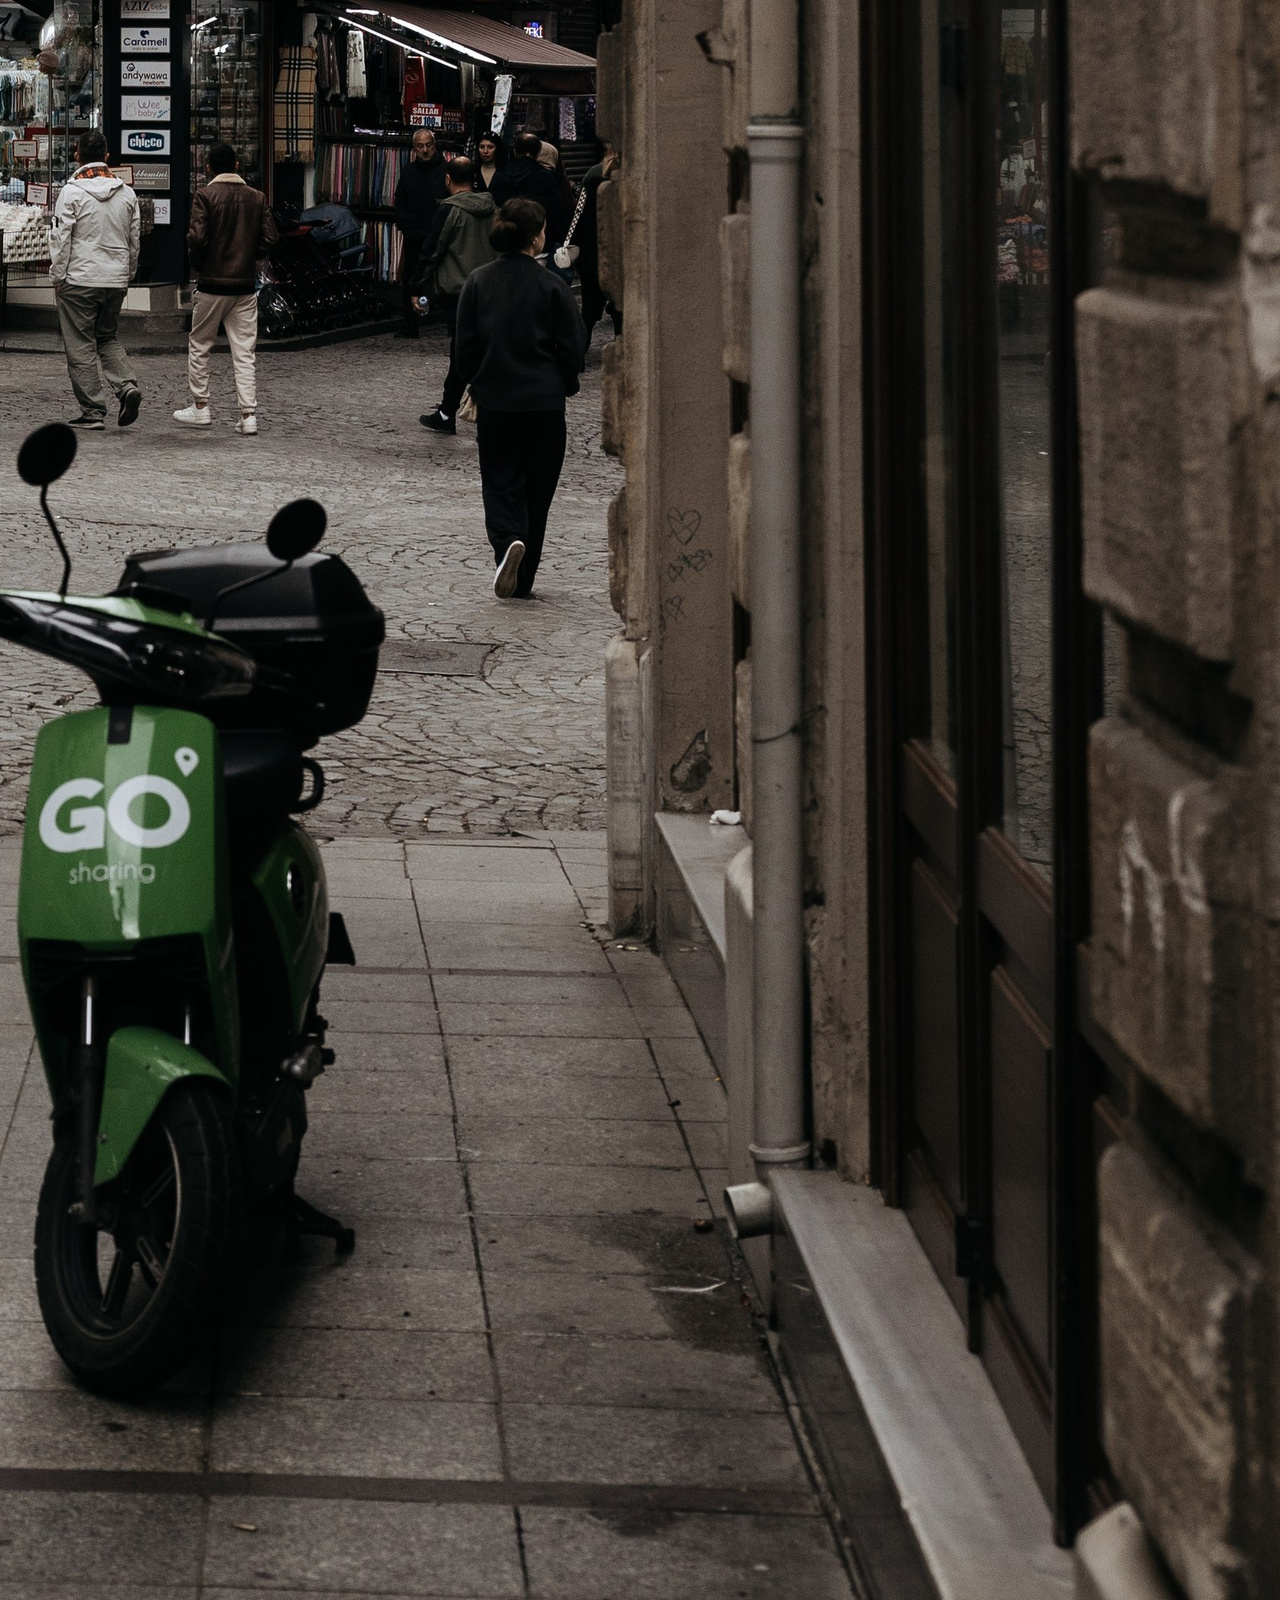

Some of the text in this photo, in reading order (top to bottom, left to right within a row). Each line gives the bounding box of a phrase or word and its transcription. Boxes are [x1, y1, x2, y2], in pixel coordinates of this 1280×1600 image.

[123, 37, 168, 46] Caramell
[122, 70, 168, 81] andywawa
[137, 100, 161, 109] Wee
[137, 109, 157, 119] baby
[129, 132, 163, 149] chicco
[38, 774, 192, 853] GO
[68, 860, 156, 885] sharing
